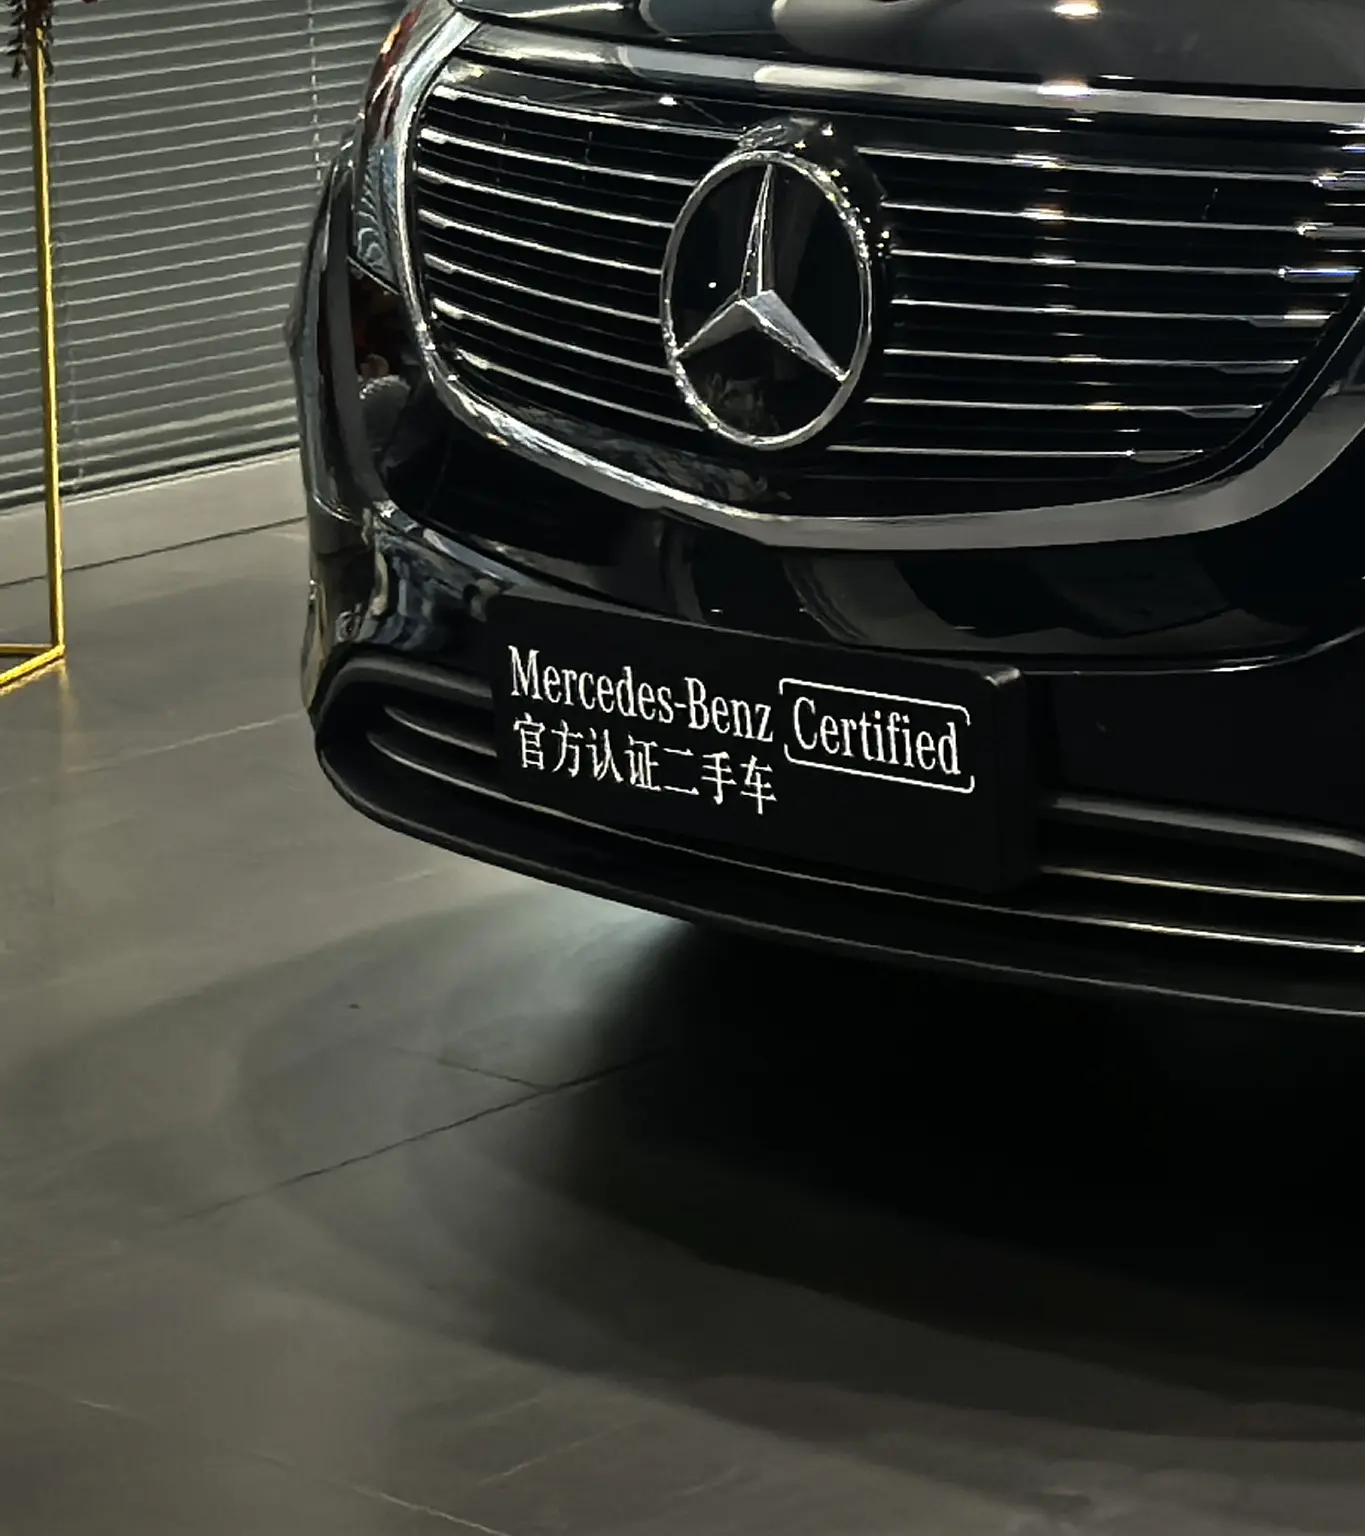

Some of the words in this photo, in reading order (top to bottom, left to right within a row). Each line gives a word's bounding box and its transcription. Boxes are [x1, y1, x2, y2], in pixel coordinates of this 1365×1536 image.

[508, 644, 774, 743] Mercedes-Benz
[794, 696, 962, 775] Certified
[513, 712, 777, 815] 官方认证二手车
